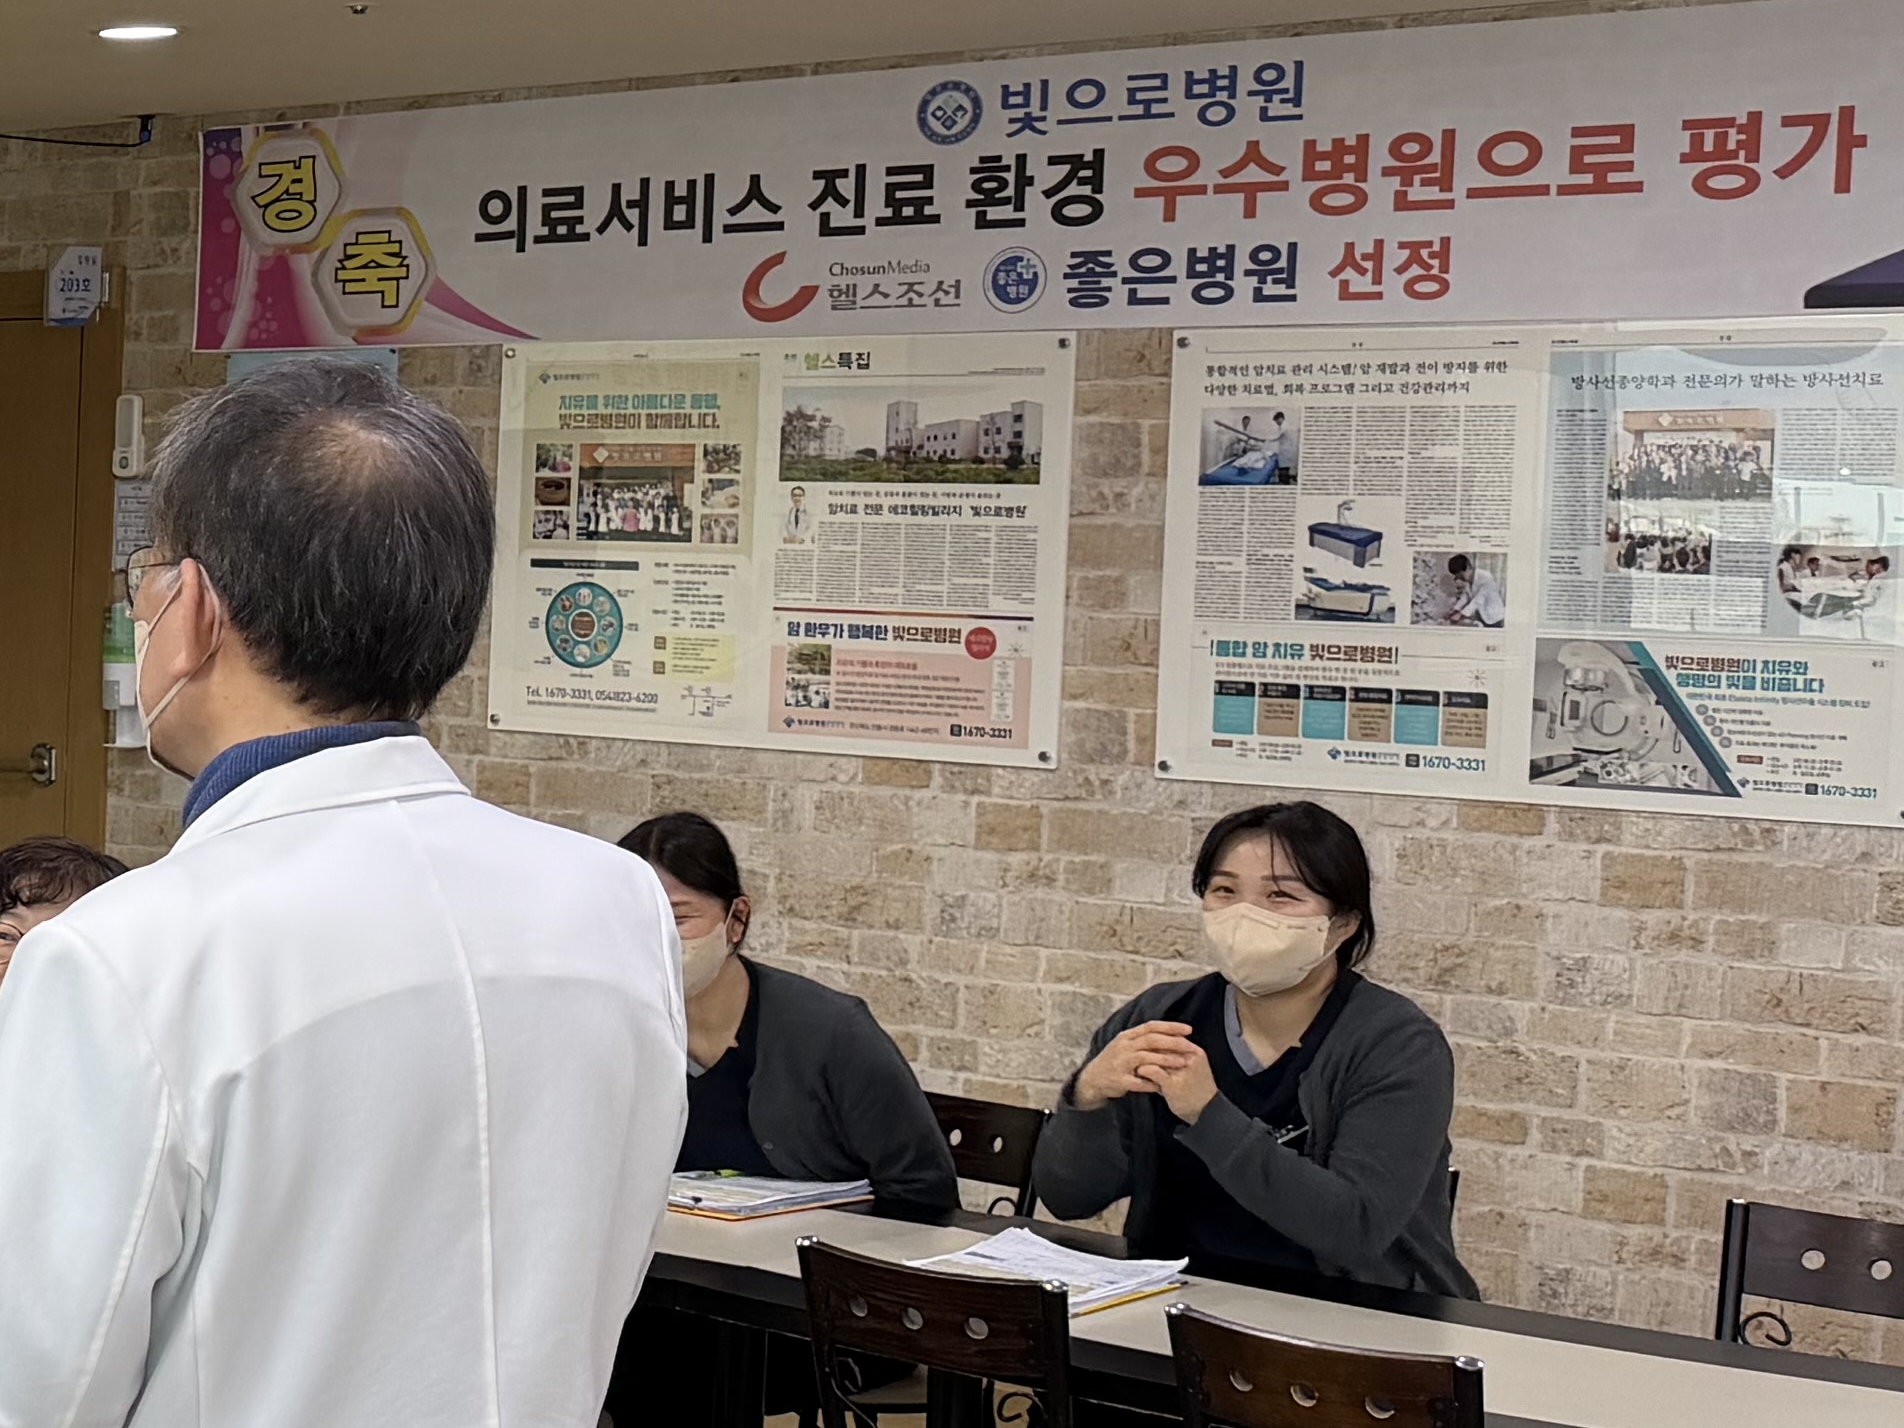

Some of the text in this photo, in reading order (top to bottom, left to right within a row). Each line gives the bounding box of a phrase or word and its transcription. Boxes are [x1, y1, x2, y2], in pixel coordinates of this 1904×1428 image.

[1000, 60, 1306, 138] 빛으로병원
[252, 156, 319, 232] 경
[473, 105, 1869, 254] 의료서비스 진료 환경 우수병원으로 평가
[334, 230, 410, 308] 축
[827, 278, 961, 311] 헬스조선
[829, 259, 931, 277] ChosunMedia
[1062, 236, 1454, 310] 좋은병원 선정
[1422, 755, 1486, 772] 1670-3331
